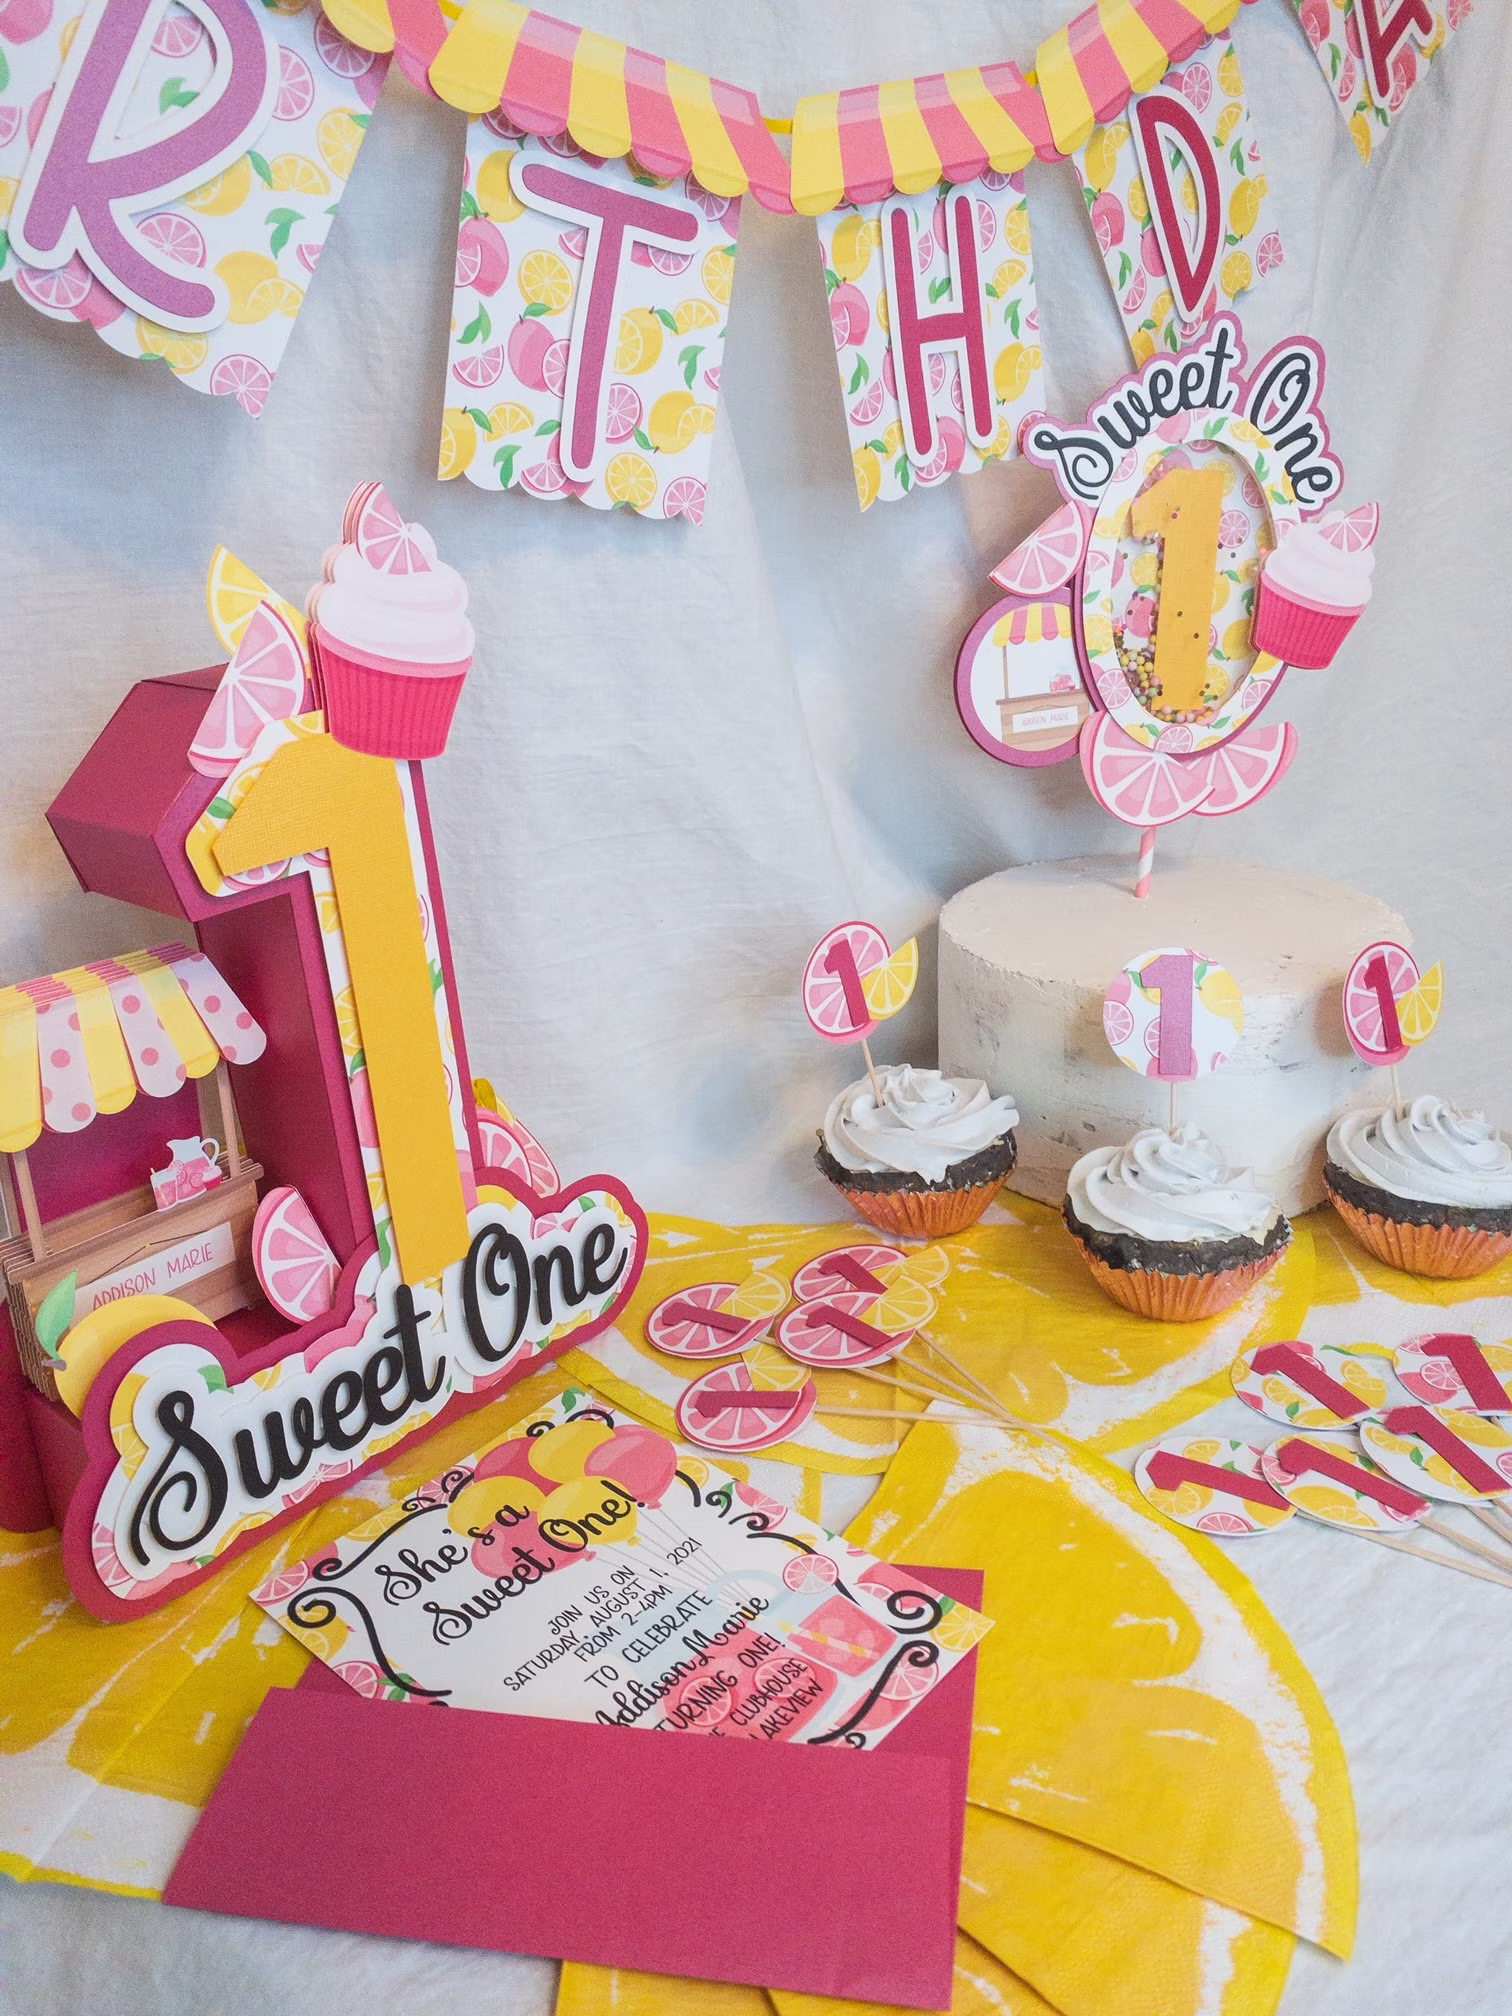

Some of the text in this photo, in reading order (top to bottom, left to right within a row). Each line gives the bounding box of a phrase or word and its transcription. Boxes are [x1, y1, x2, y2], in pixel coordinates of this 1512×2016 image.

[22, 0, 268, 318] R
[521, 164, 699, 469] T
[891, 195, 993, 458] H
[1136, 95, 1221, 312] D
[1034, 327, 1333, 504] Sweet One
[1131, 468, 1225, 711] 1
[212, 732, 470, 1286] 1
[824, 938, 864, 1028] 1
[1139, 954, 1193, 1076] 1
[1361, 955, 1401, 1052] 1
[93, 1242, 214, 1311] ADDISON MARIE
[662, 1301, 753, 1334] 1
[805, 1304, 895, 1349] 1
[131, 1221, 628, 1567] Sweet One
[695, 1390, 800, 1418] 1
[1250, 1343, 1371, 1419] 1
[1421, 1335, 1512, 1411] 1
[1146, 1450, 1291, 1512] 1
[1278, 1438, 1430, 1516] 1
[1385, 1405, 1512, 1493] 1
[375, 1504, 531, 1606] She's a
[422, 1480, 646, 1646] Sweet One!
[503, 1537, 703, 1692] SATURDAY, AUGUST 1, 2021
[548, 1565, 636, 1635] JOIN US ON
[574, 1584, 673, 1662] FROM 2-4PM
[584, 1590, 714, 1688] TO CELEBRATE
[682, 1596, 769, 1667] Marie
[730, 1658, 808, 1726] CLUBHOUSE
[738, 1632, 786, 1669] ONE!
